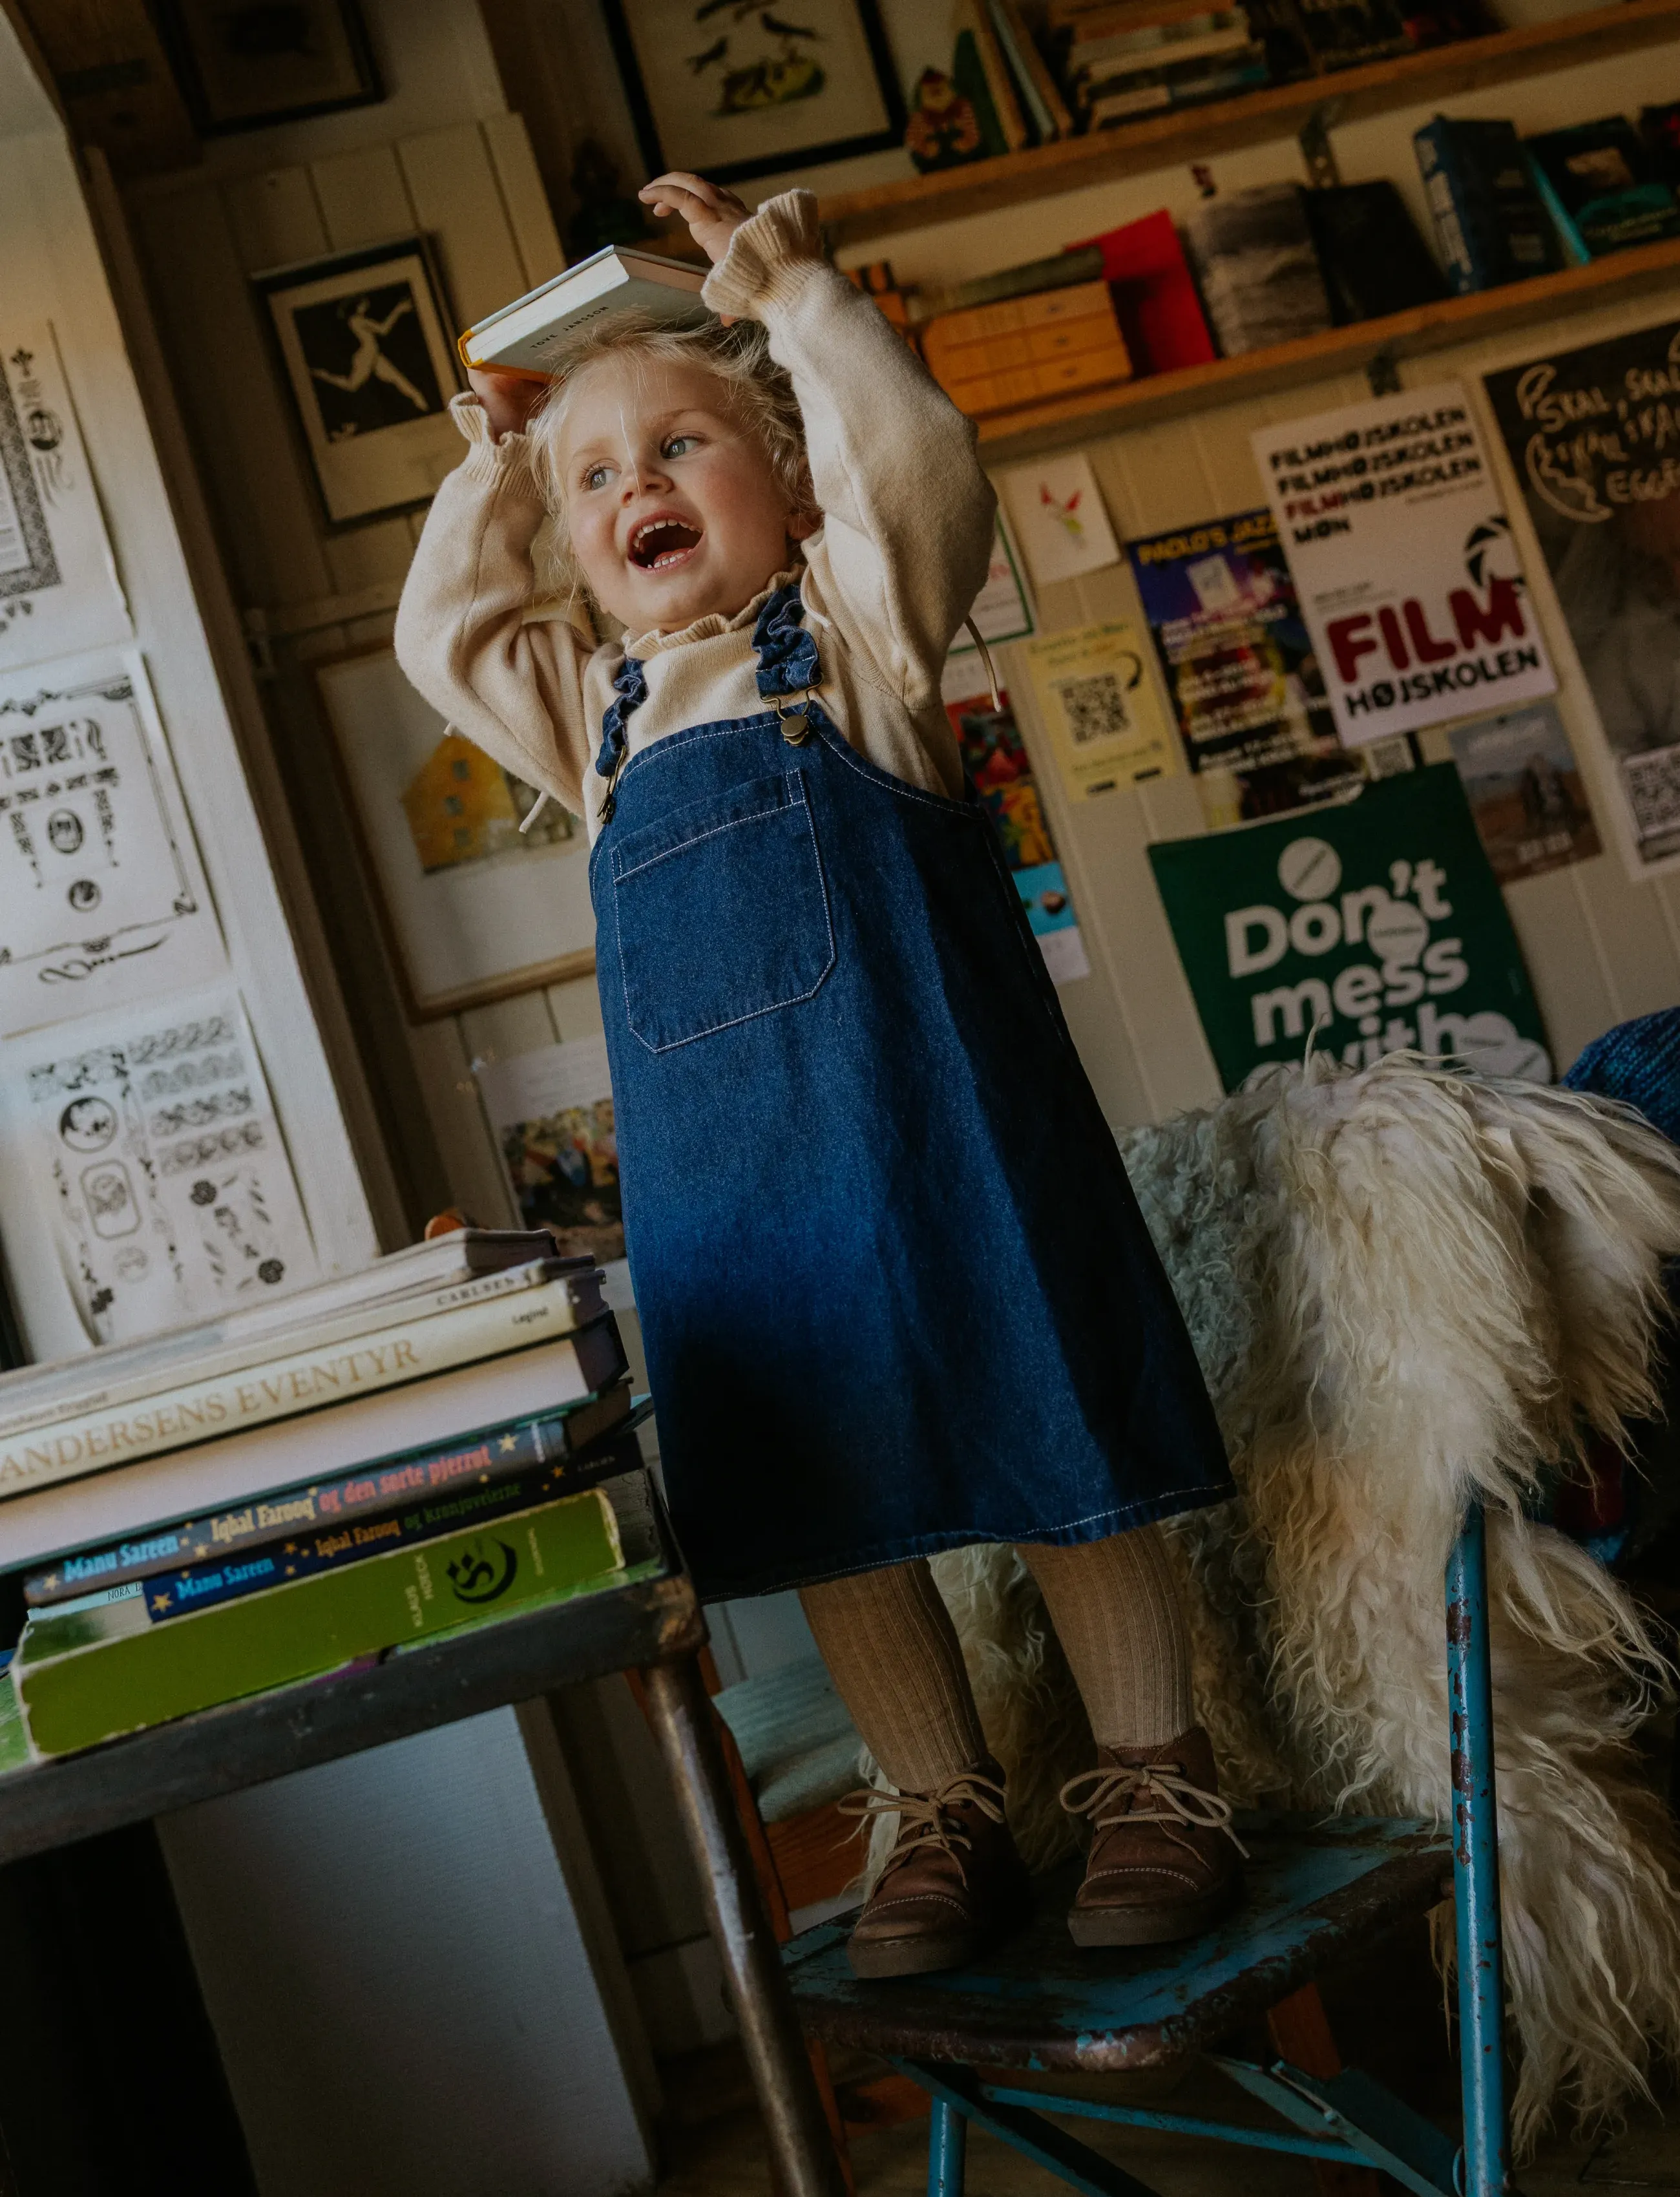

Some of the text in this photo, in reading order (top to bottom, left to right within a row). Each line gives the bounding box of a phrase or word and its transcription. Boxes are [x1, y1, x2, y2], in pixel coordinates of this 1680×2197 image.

[529, 305, 610, 350] TOVE JANSSON
[1269, 405, 1467, 469] FILMHØJSKOLEN
[1277, 430, 1474, 495] FILMHØJSKOLEN
[1285, 456, 1482, 520] FILMHØJSKOLEN
[1293, 519, 1352, 545] MØN
[1325, 574, 1527, 684] FILM
[1344, 648, 1541, 718] HØJSKOLEN
[1224, 858, 1453, 979] Don't
[1251, 938, 1469, 1047] mess
[0, 1391, 227, 1484] ANDERSENS
[235, 1338, 420, 1414] EVENTYR
[63, 1549, 118, 1583] Manu
[120, 1533, 180, 1567] Sareen
[209, 1509, 257, 1544] Iqbal
[319, 1489, 342, 1514] og
[344, 1480, 376, 1504] den
[107, 1586, 131, 1601] NORA
[175, 1572, 224, 1601] Manu
[224, 1557, 275, 1585] Sareen
